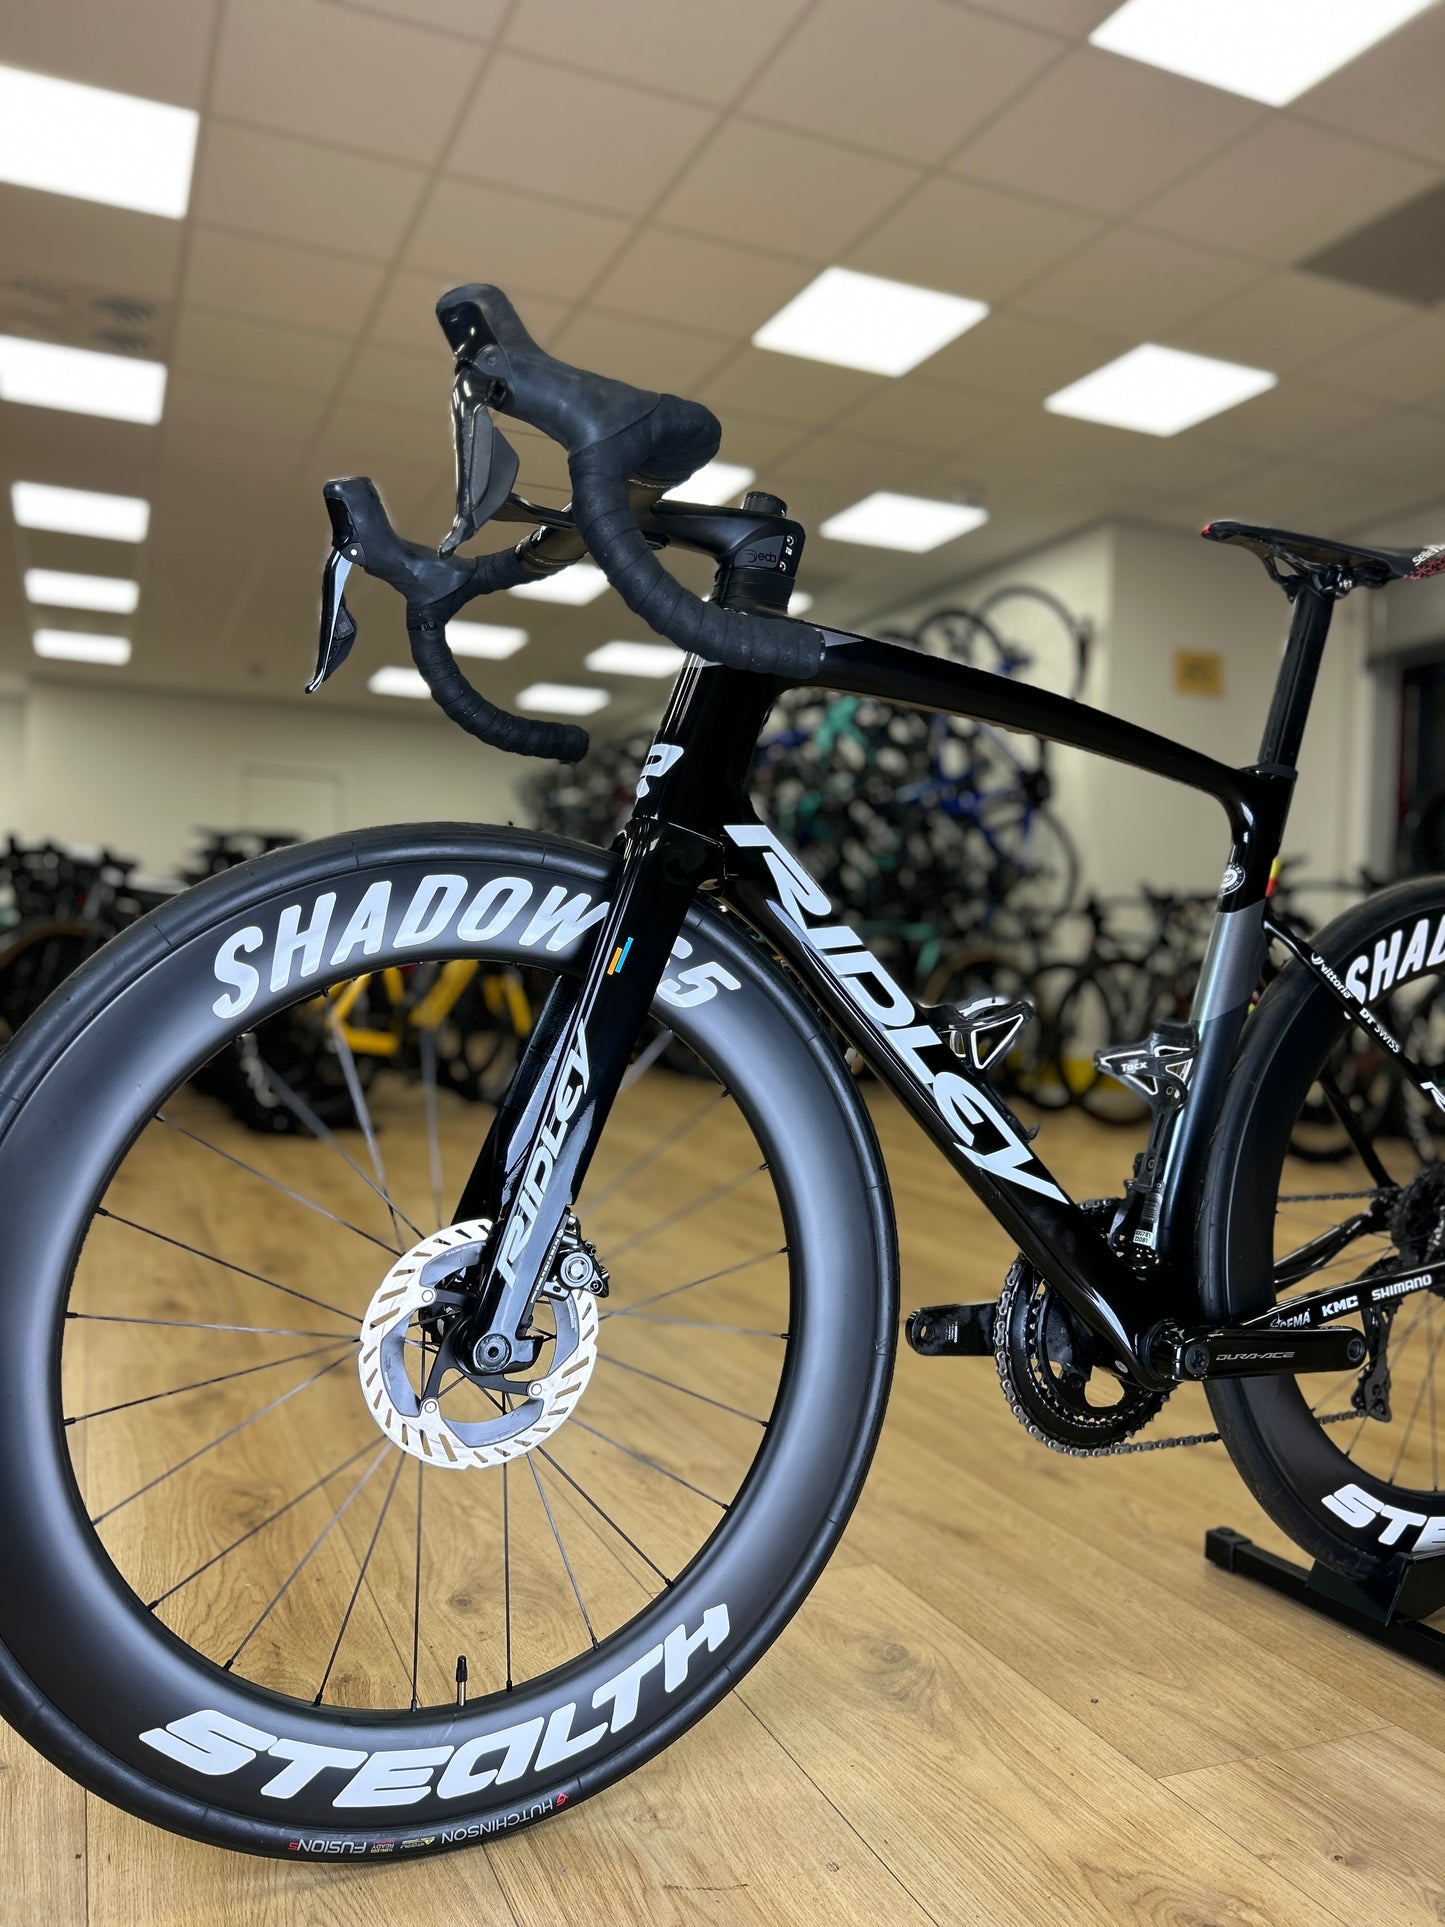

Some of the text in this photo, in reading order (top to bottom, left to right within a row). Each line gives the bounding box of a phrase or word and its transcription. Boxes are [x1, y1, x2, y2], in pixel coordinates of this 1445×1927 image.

[212, 874, 611, 1019] SHADOW
[1320, 962, 1351, 1000] vittoria
[724, 824, 1070, 1205] RIDLEY
[1359, 1007, 1401, 1054] DT SWISS
[1121, 1061, 1148, 1073] Tacx
[497, 1017, 591, 1290] RIDLEY
[1321, 1295, 1359, 1317] KMC
[1371, 1274, 1433, 1301] SHIMANO
[1215, 1351, 1296, 1361] DURA-ACE
[139, 1603, 730, 1807] STEALTH
[441, 1798, 554, 1844] HUTCHINSON
